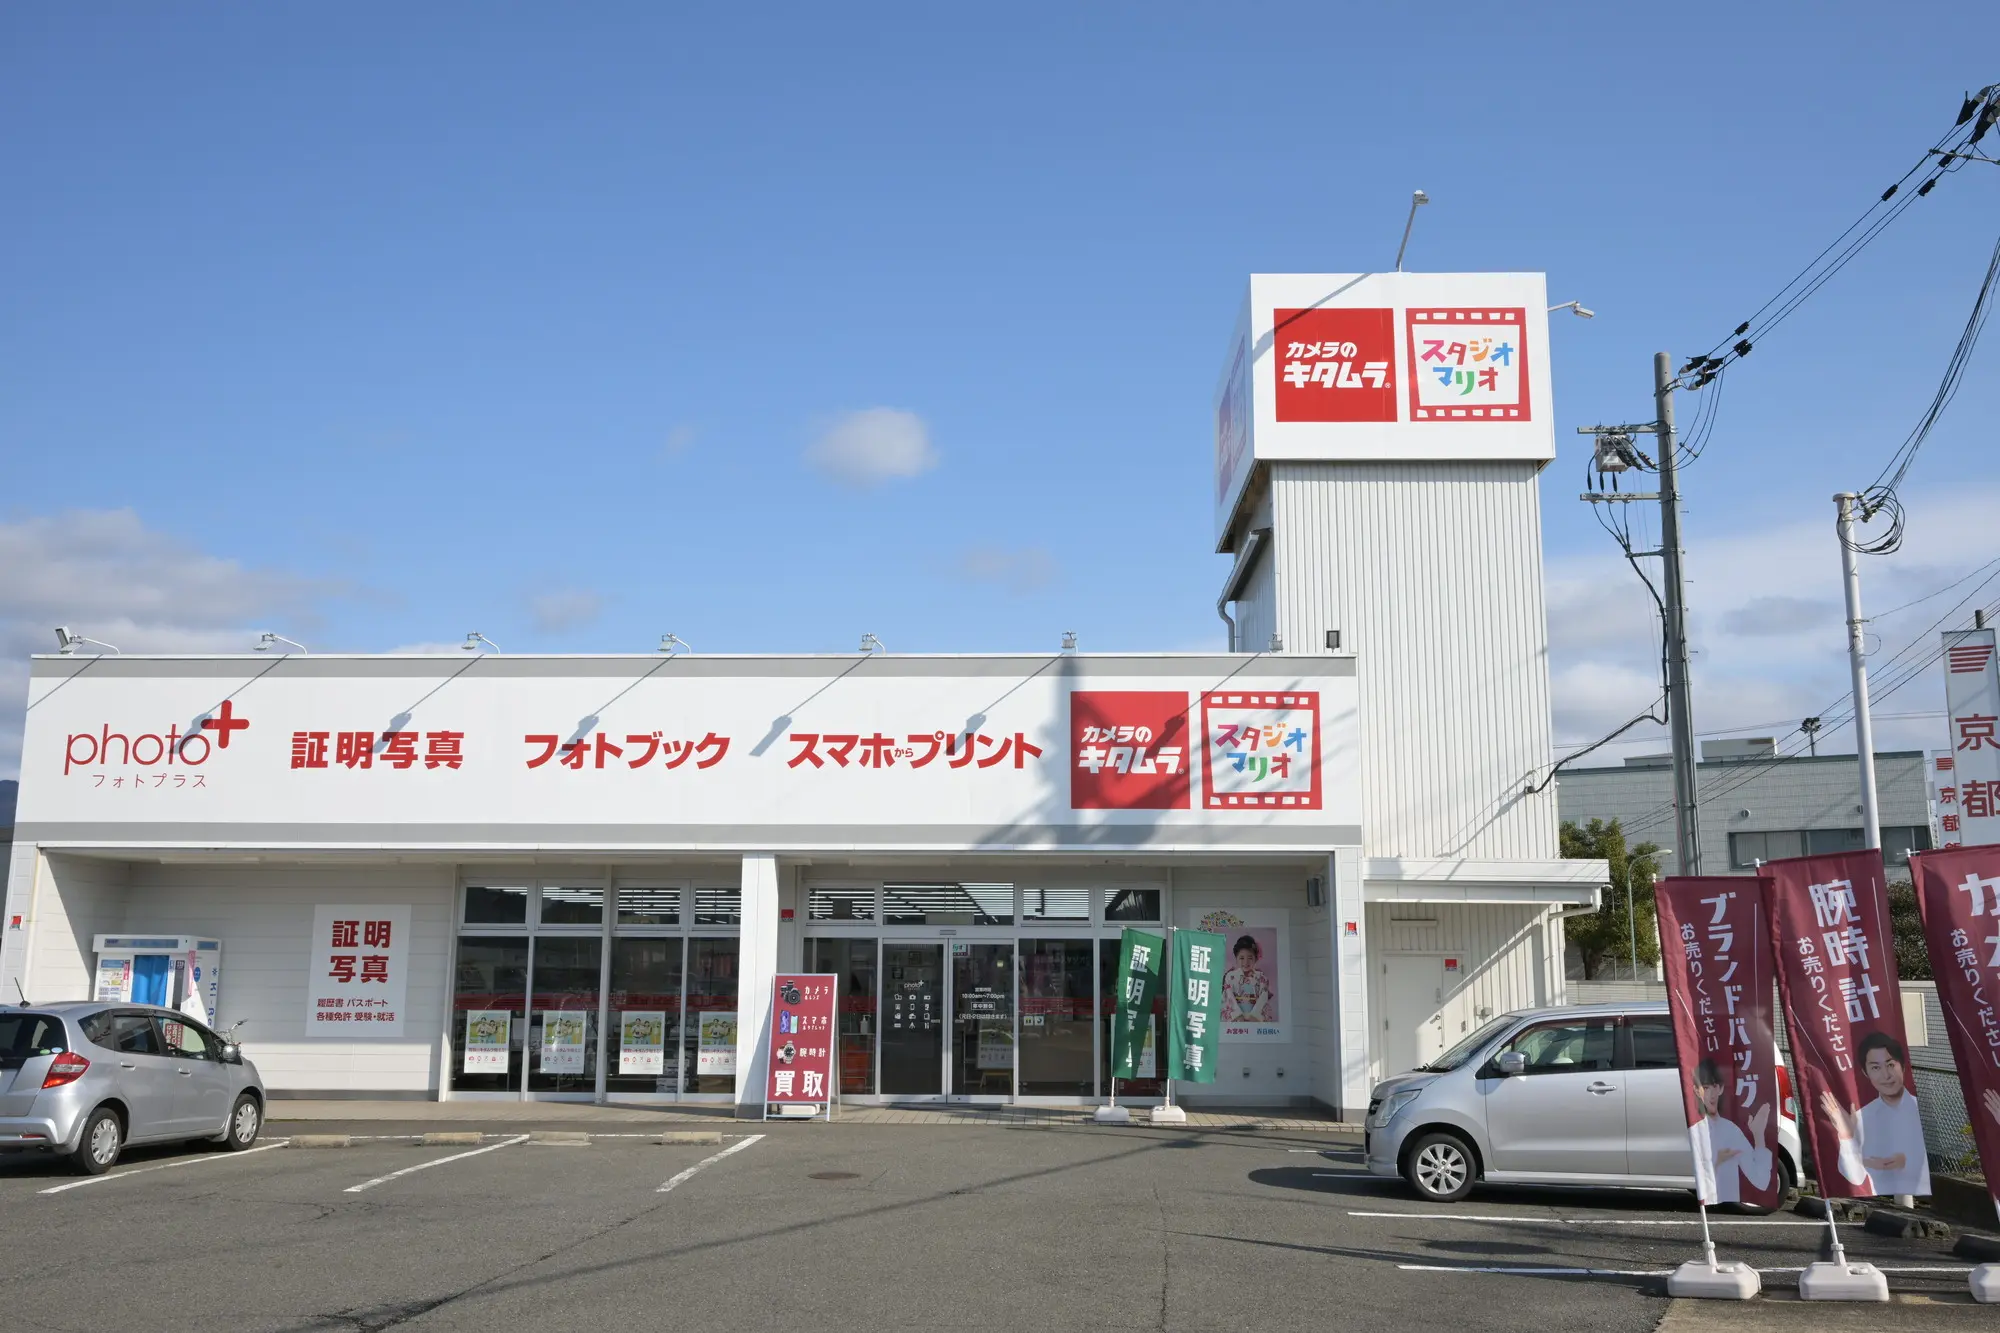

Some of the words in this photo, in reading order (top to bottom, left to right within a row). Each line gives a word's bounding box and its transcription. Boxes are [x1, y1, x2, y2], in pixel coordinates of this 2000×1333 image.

[1286, 341, 1358, 358] カメラの
[1421, 337, 1514, 366] スタジオ
[1283, 361, 1390, 388] キタムラ
[1433, 366, 1499, 396] マリオ
[1081, 726, 1152, 743] カメラの
[1215, 723, 1307, 753] スタジオ
[291, 730, 465, 770] 証明写真
[524, 731, 731, 770] フォトブック
[787, 731, 1043, 769] スマホからプリント
[1078, 747, 1183, 774] キタムラ
[93, 773, 206, 788] フォトプラス
[1226, 752, 1291, 783] マリオ
[1955, 714, 2000, 818] 京都
[1939, 786, 1961, 848] 京都
[332, 920, 391, 948] 証明
[1808, 879, 1880, 1024] 腕時計
[329, 954, 389, 984] 写真
[805, 985, 829, 996] カメラ
[1680, 922, 1720, 1052] お売りください
[1700, 891, 1758, 1108] ブランドバッグ
[316, 1011, 352, 1022] 各種免許
[317, 998, 345, 1008] 履歴書
[347, 998, 389, 1008] パスポート
[1184, 944, 1212, 1072] 証明写真
[1796, 936, 1852, 1072] お売りください
[802, 1015, 828, 1025] スマホ
[799, 1047, 826, 1058] 腕時計
[774, 1070, 824, 1098] 買取
